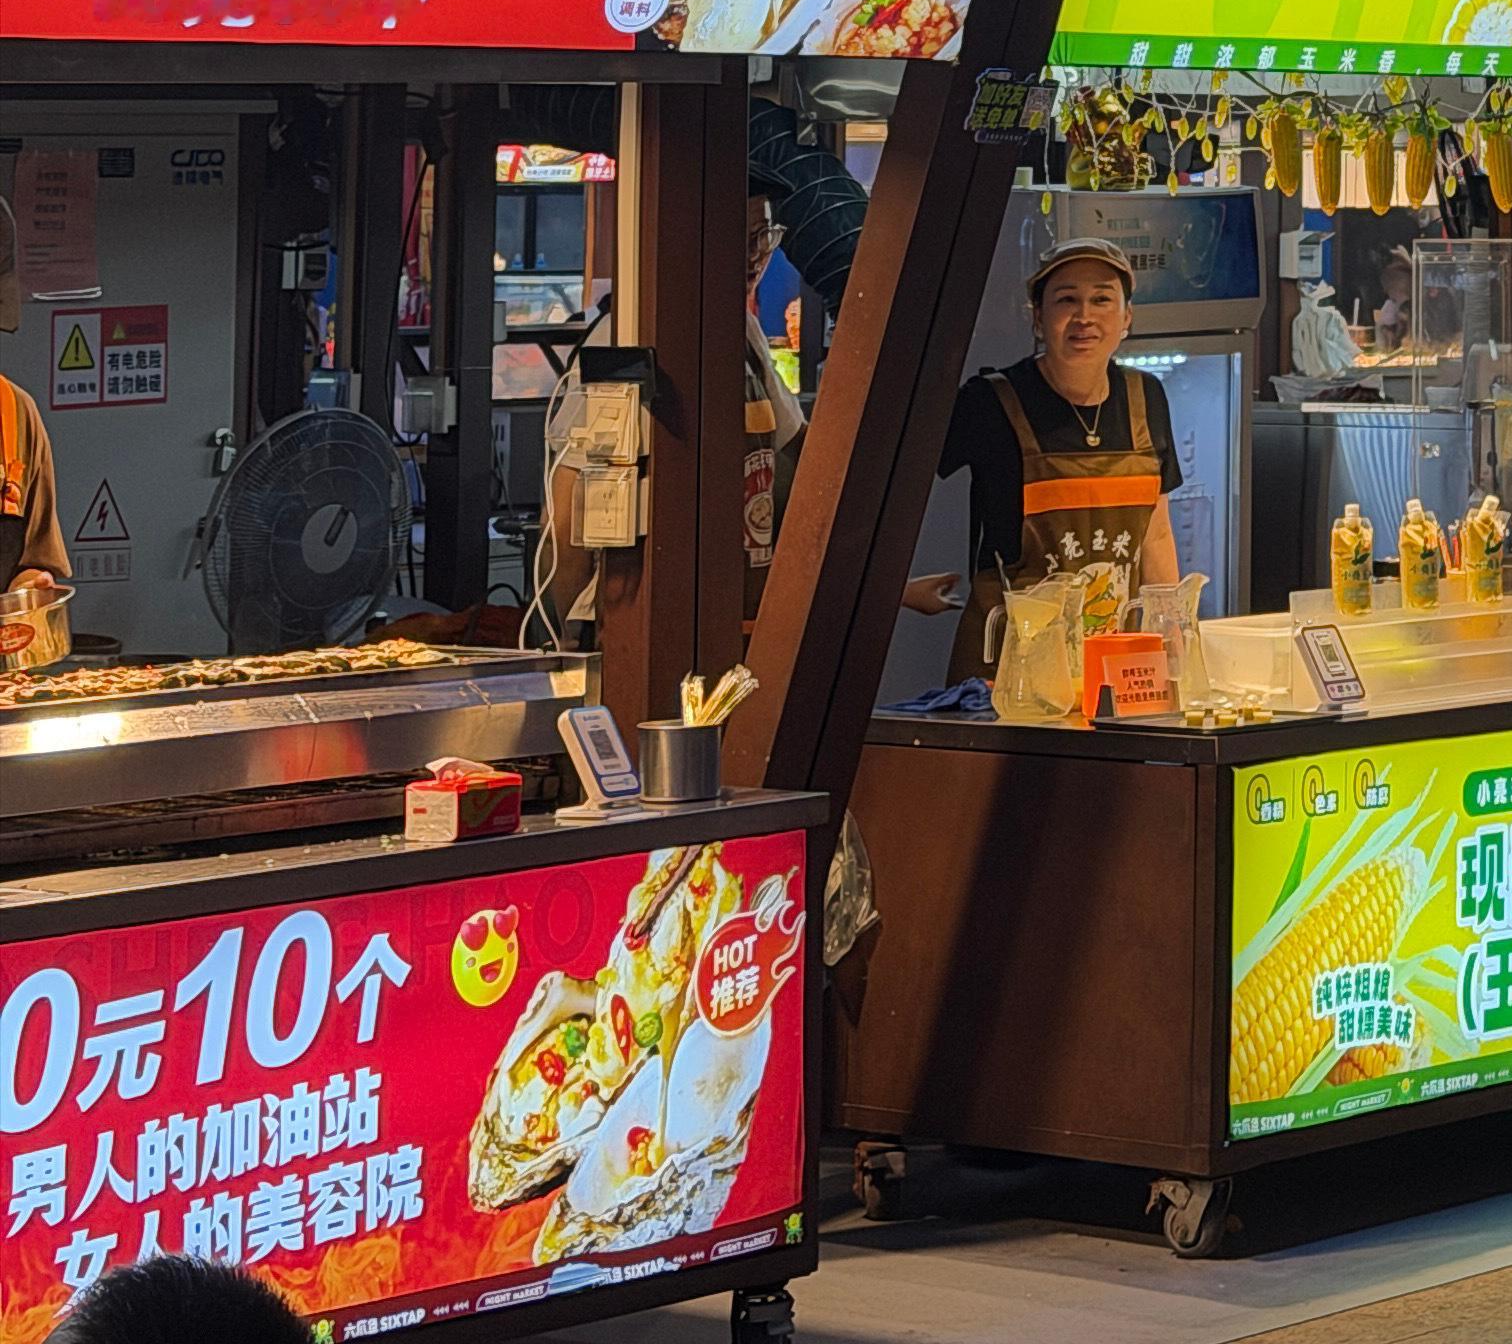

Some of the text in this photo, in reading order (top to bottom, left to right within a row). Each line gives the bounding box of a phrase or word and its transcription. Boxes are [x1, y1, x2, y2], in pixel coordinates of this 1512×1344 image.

[712, 934, 758, 967] HOT
[710, 967, 760, 1019] 推荐
[8, 1066, 383, 1238] 男人的加油站
